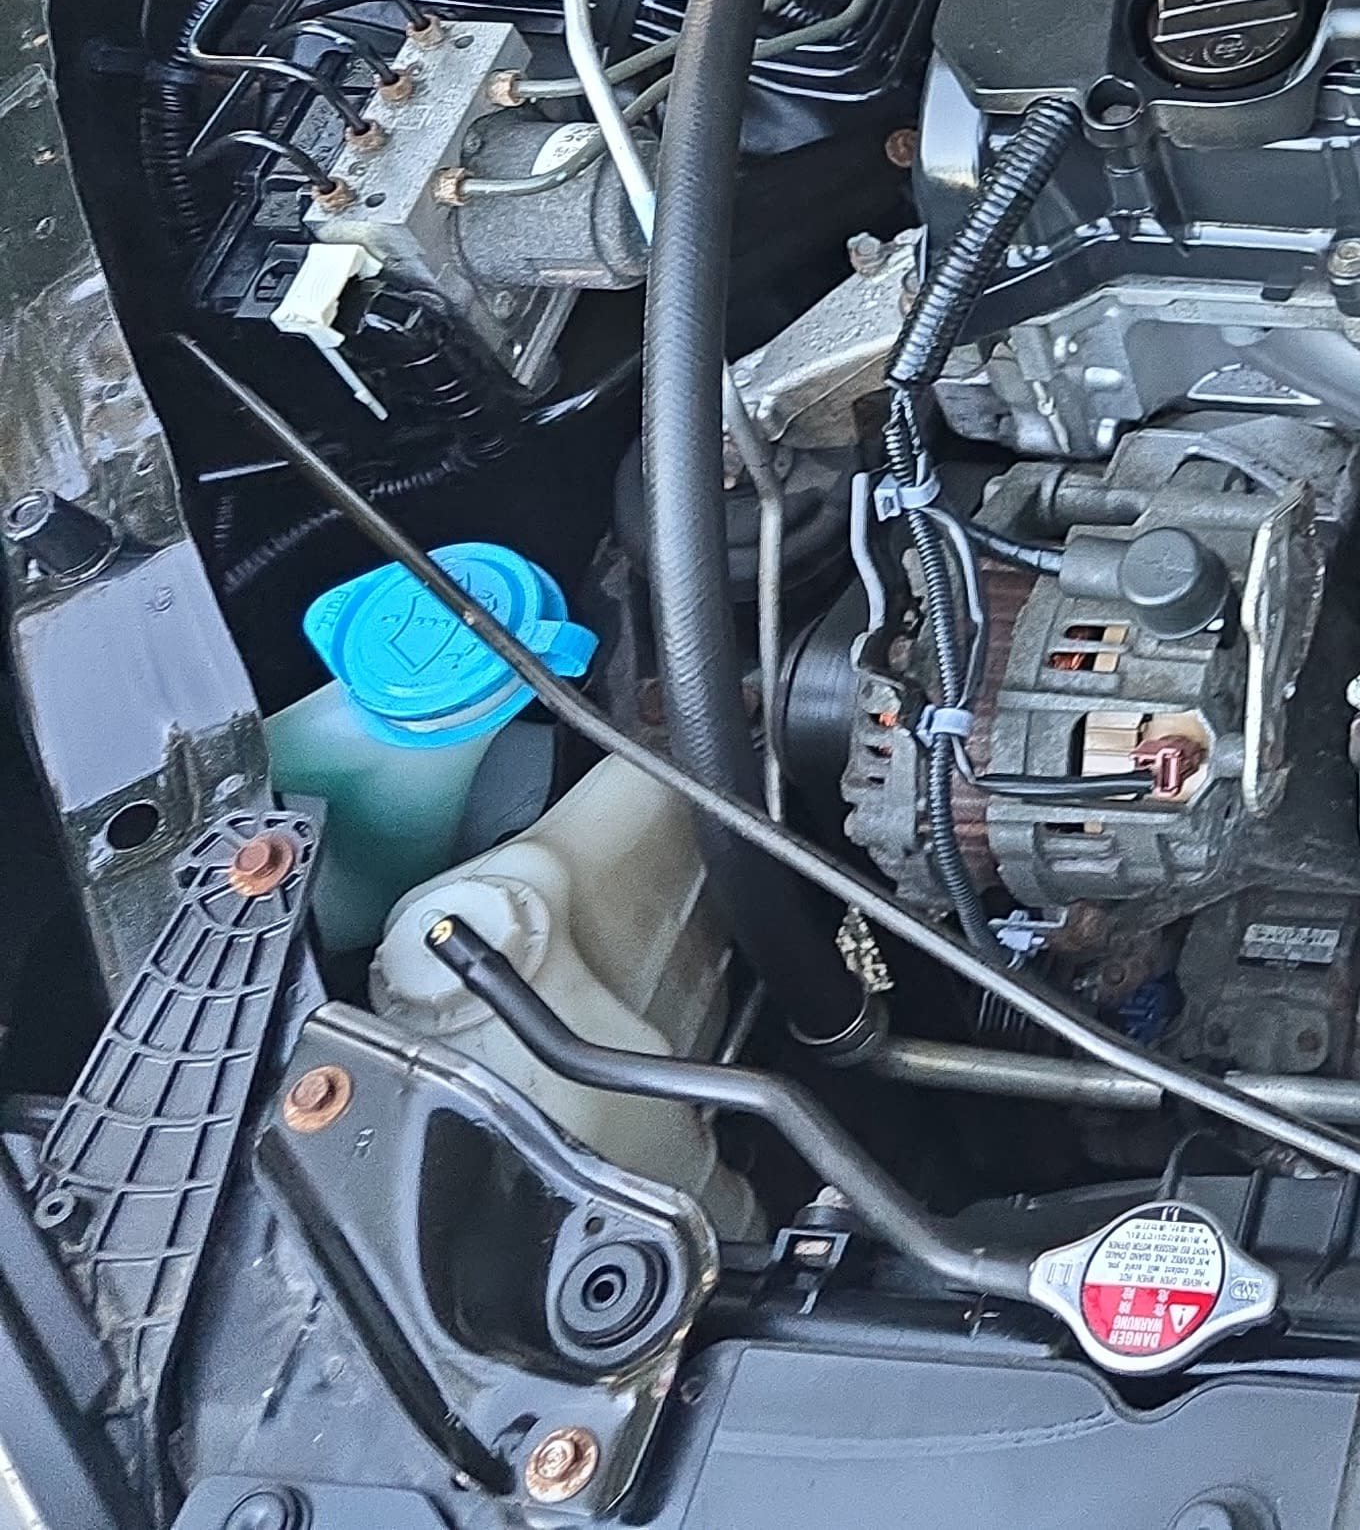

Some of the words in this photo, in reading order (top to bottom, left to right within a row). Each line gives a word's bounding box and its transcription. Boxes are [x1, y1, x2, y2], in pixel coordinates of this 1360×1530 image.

[1129, 1252, 1152, 1262] QUAND
[1155, 1253, 1167, 1263] PAS
[1165, 1266, 1189, 1275] coolant
[1138, 1274, 1155, 1284] WHEN
[1160, 1276, 1178, 1286] OPEN
[1181, 1277, 1202, 1287] NEVER
[1112, 1315, 1163, 1333] WARNUNG
[1108, 1330, 1160, 1348] DANGER
